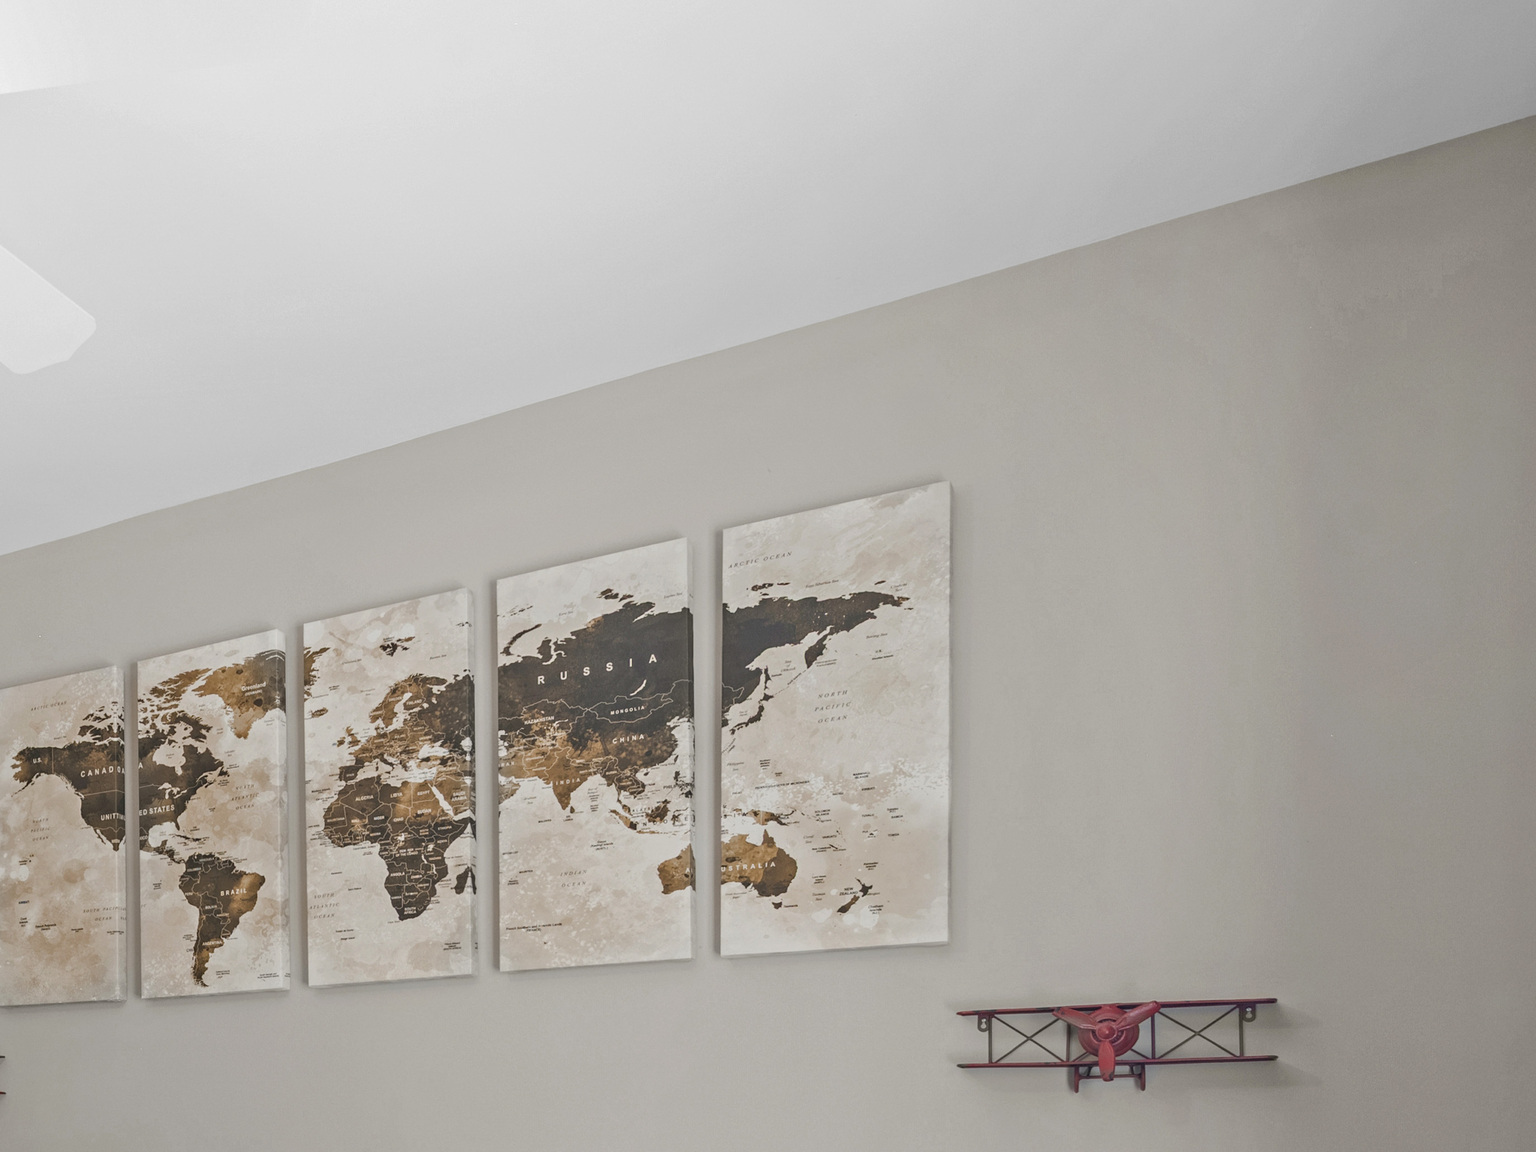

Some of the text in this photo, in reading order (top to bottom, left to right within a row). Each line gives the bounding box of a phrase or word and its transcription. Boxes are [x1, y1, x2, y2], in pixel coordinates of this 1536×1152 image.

[728, 551, 793, 569] ARCTIC OCEAN
[537, 654, 658, 685] RUSSIA
[818, 690, 848, 699] NORTH
[610, 705, 646, 715] MONGOLIA
[814, 702, 852, 712] PACIFIC
[817, 715, 848, 723] OCEAN
[612, 733, 645, 744] CHINA
[555, 777, 581, 786] INDIA
[149, 804, 175, 815] STATES
[560, 869, 588, 877] INDIAN
[220, 888, 248, 897] BRAZIL
